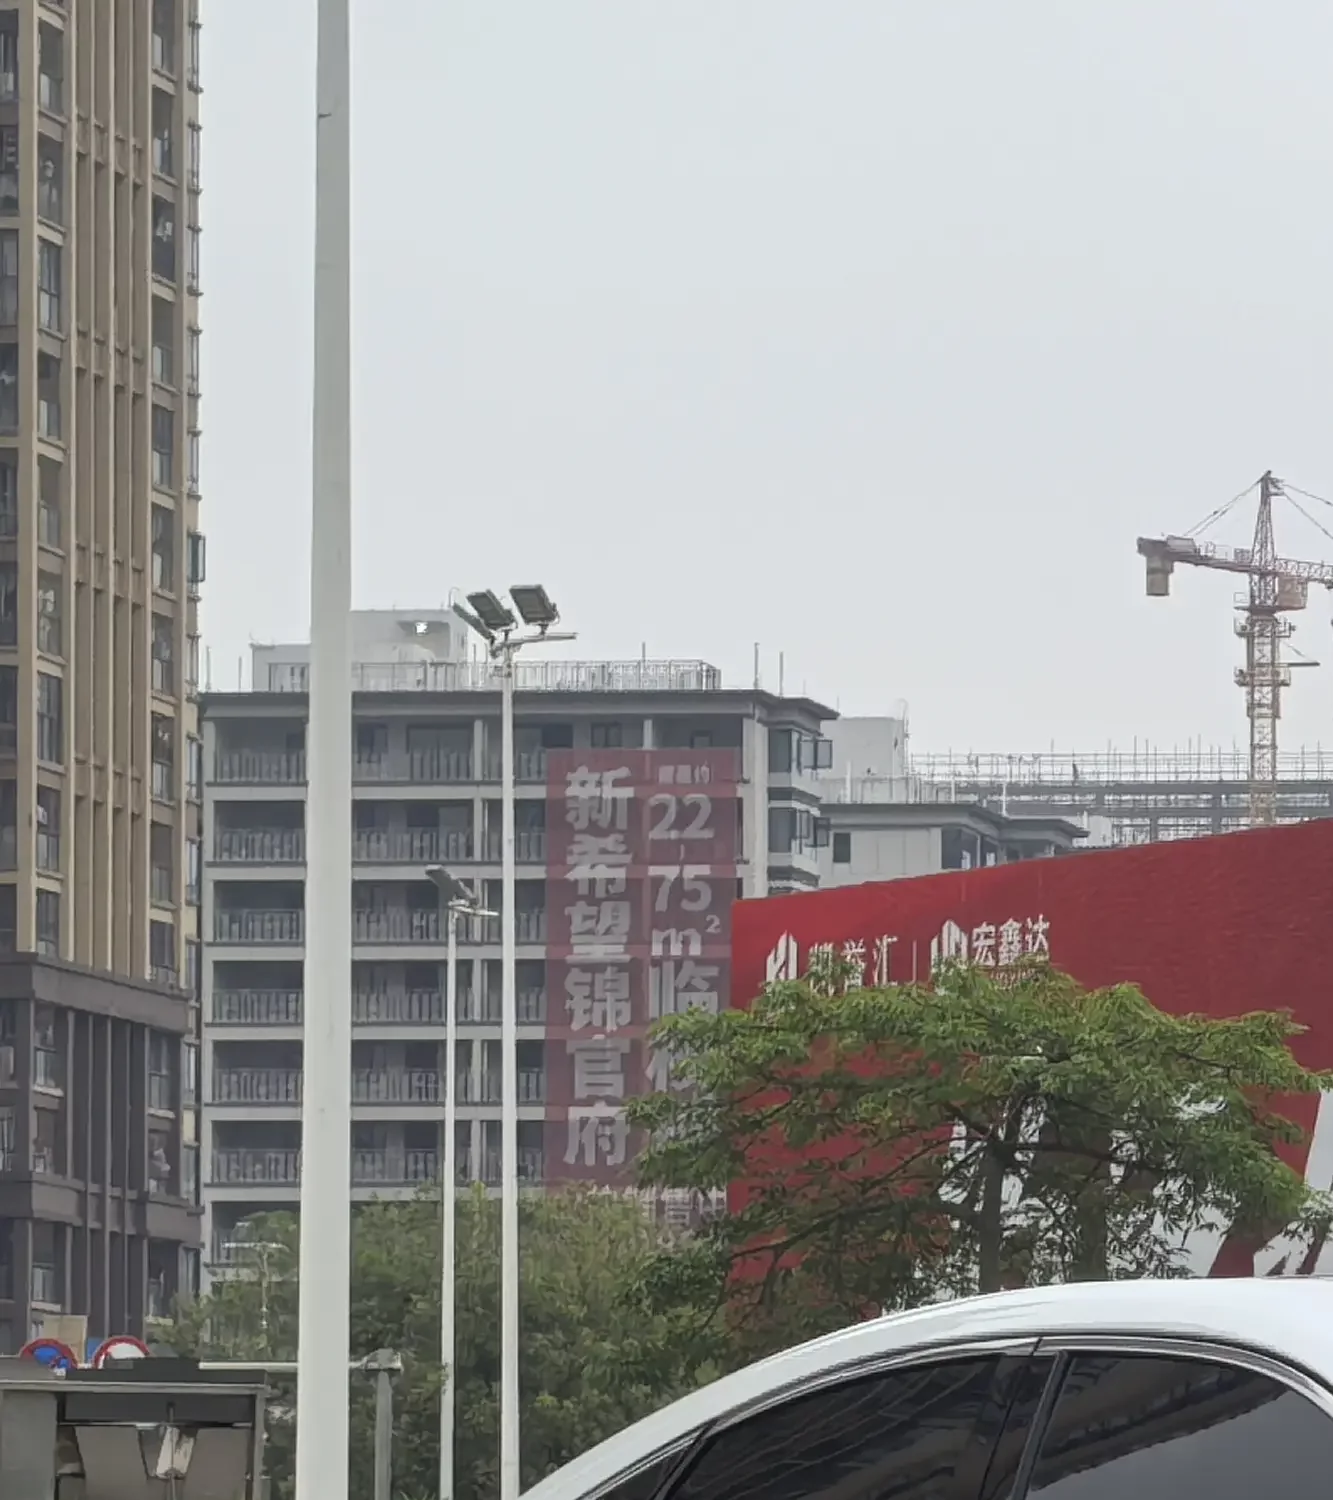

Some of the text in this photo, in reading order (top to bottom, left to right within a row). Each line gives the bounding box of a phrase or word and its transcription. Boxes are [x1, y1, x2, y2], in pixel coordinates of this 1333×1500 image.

[562, 764, 635, 1166] 新希望锦官府
